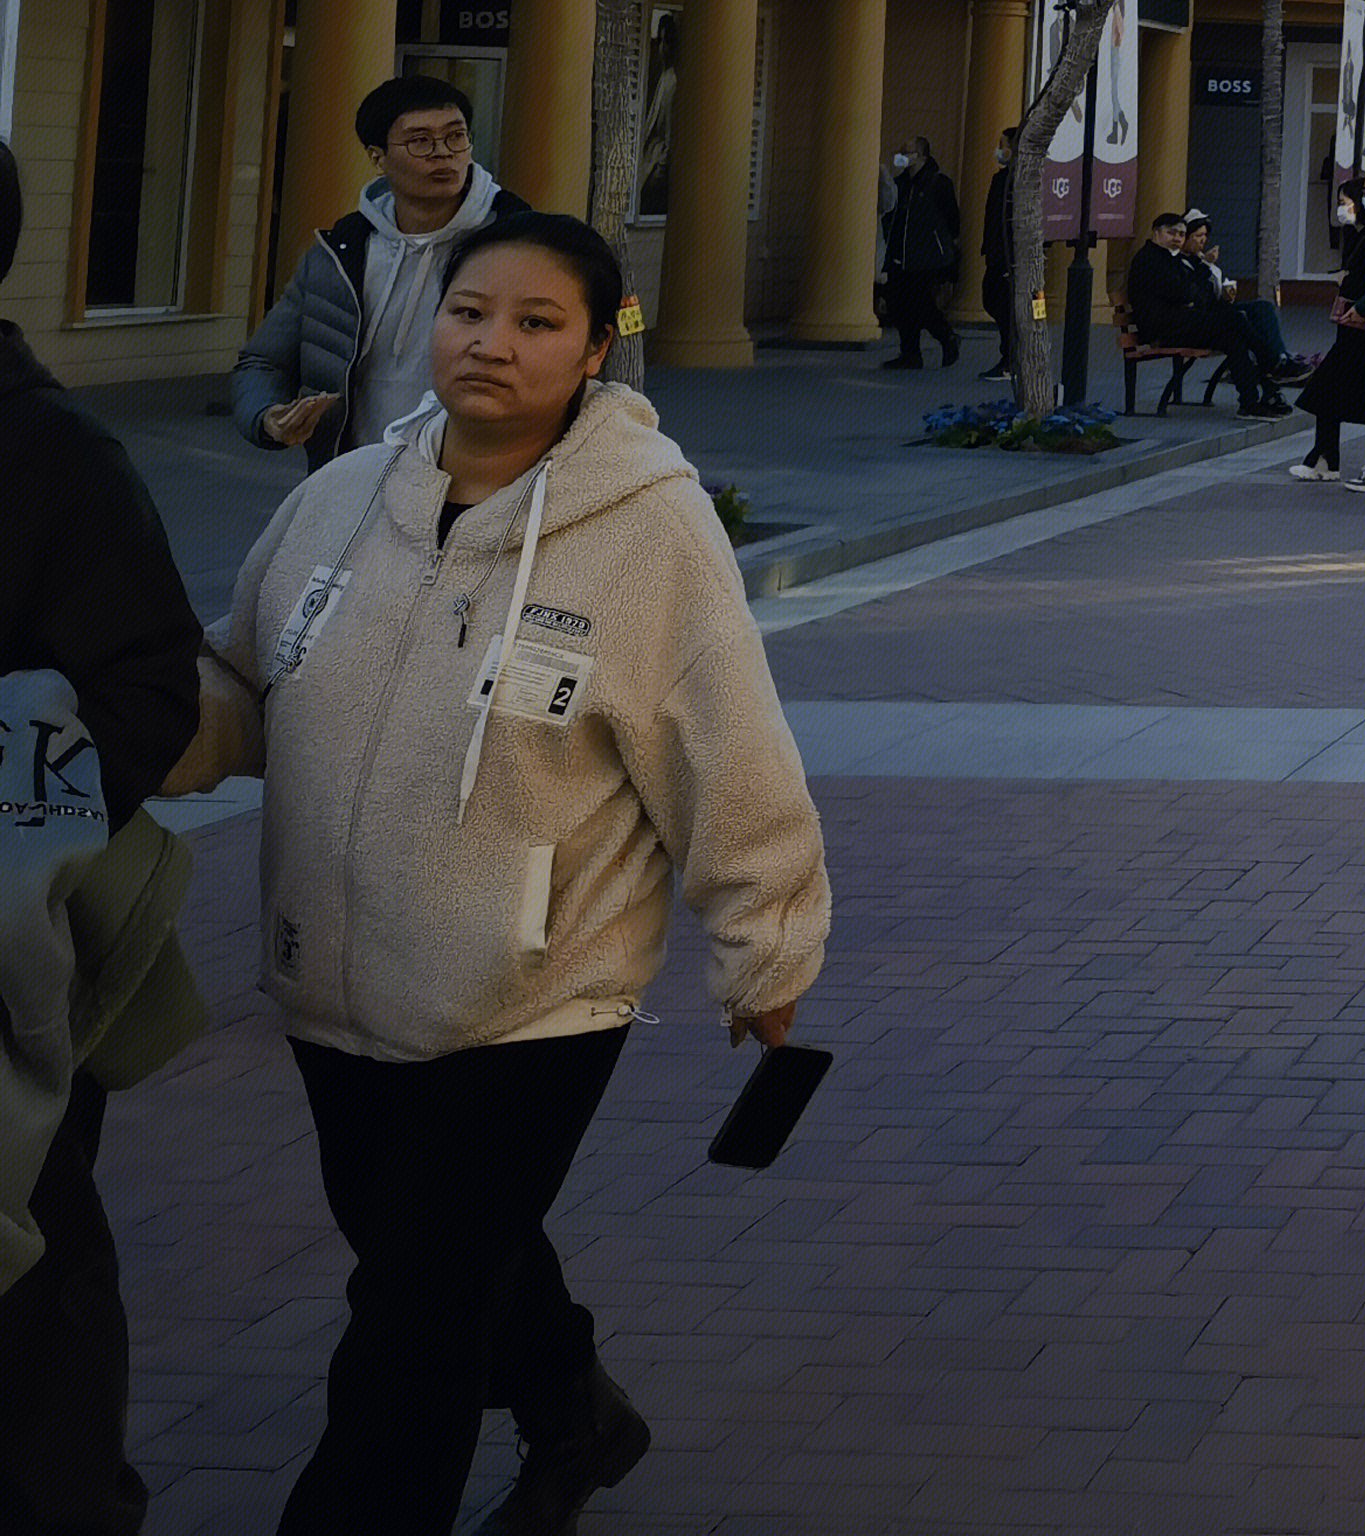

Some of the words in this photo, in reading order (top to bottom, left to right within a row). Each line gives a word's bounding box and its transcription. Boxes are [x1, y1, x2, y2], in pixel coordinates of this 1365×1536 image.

[458, 10, 510, 30] BOS
[1207, 79, 1252, 94] BOSS
[1052, 178, 1070, 199] UGG
[1103, 179, 1122, 198] UGG
[553, 687, 572, 707] 2
